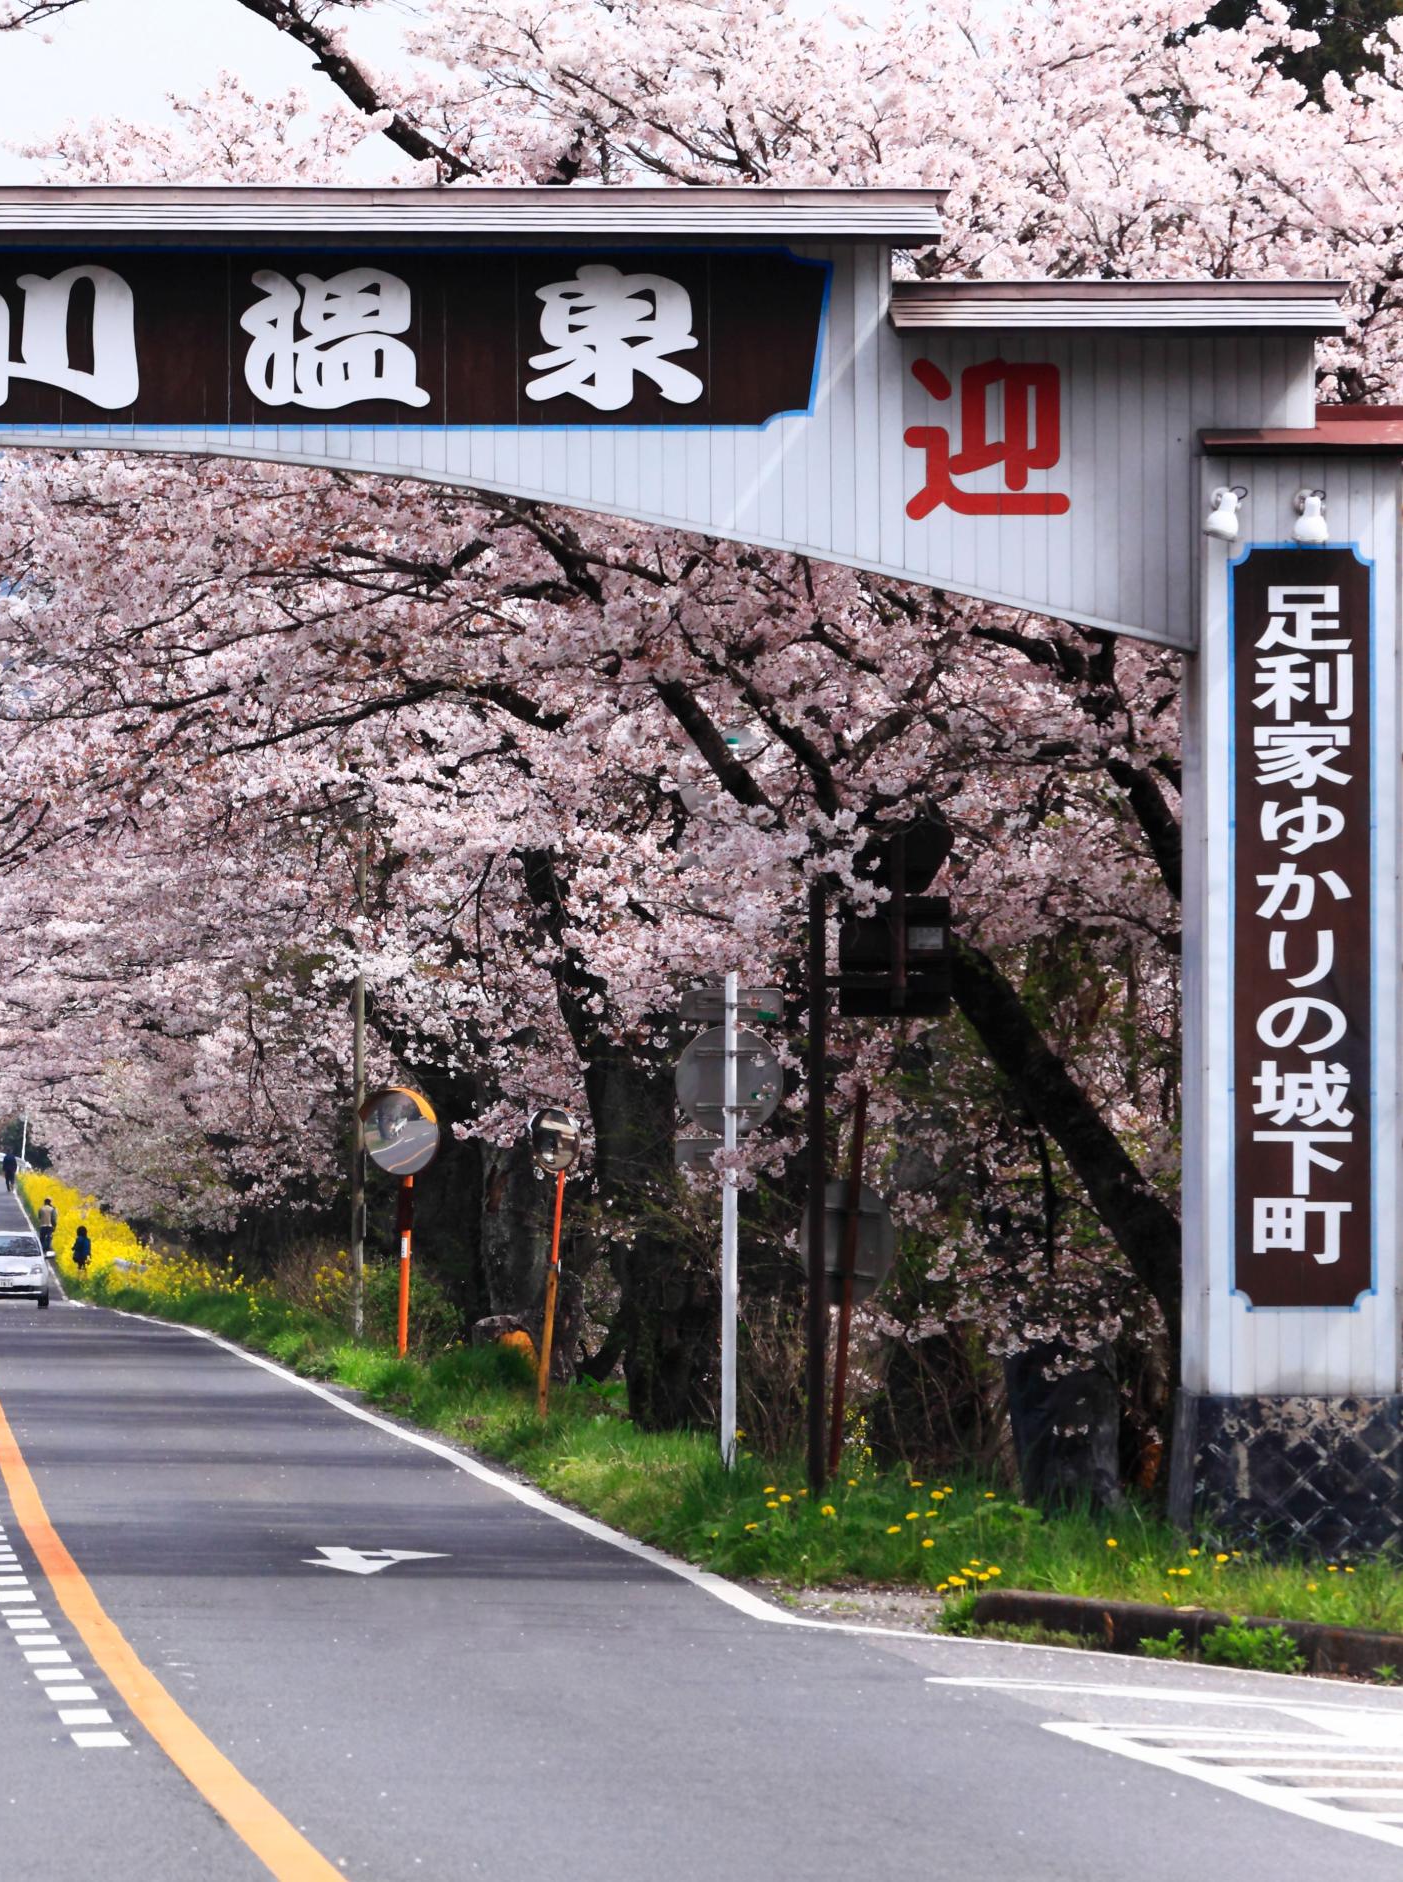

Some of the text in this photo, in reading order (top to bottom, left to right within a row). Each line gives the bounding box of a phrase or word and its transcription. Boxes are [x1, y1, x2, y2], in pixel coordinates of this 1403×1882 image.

[903, 357, 1071, 521] 迎
[1251, 584, 1354, 1265] 足利家ゆかりの城下町
